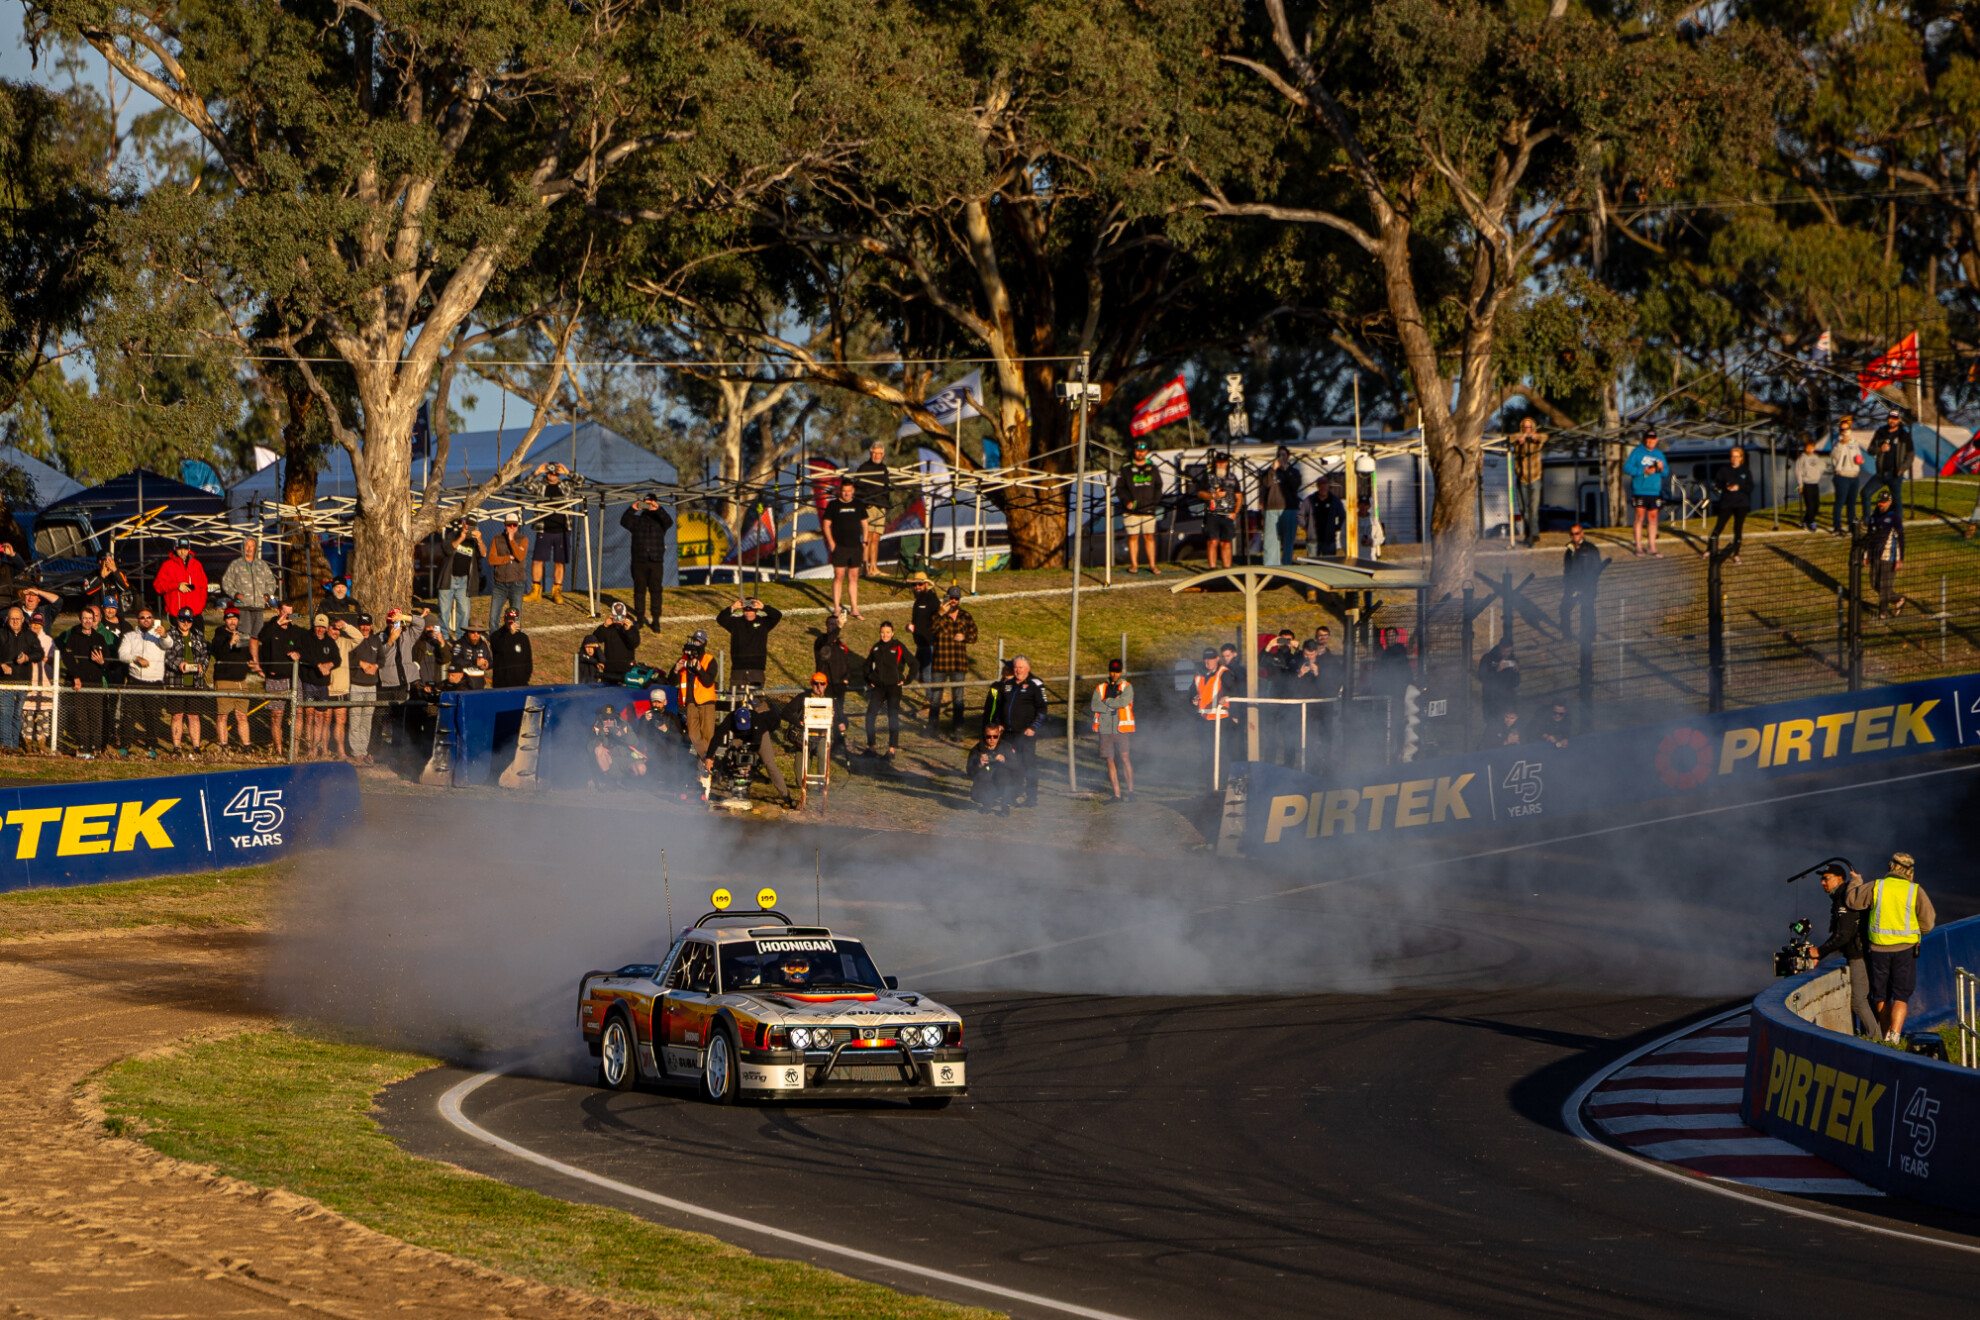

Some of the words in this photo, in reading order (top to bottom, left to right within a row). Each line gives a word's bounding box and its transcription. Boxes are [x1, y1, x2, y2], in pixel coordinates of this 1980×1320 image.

[1718, 699, 1941, 776] PIRTEK
[1502, 760, 1543, 803] 45
[0, 797, 182, 860] TEK
[224, 786, 284, 833] 45
[1264, 773, 1476, 843] PIRTEK
[1507, 802, 1542, 818] YEARS
[230, 833, 283, 848] YEARS
[715, 895, 730, 903] 199
[760, 894, 775, 902] 199
[1765, 1047, 1887, 1153] PIRTEK
[1902, 1086, 1941, 1158] 45
[1900, 1154, 1929, 1179] YEARS
